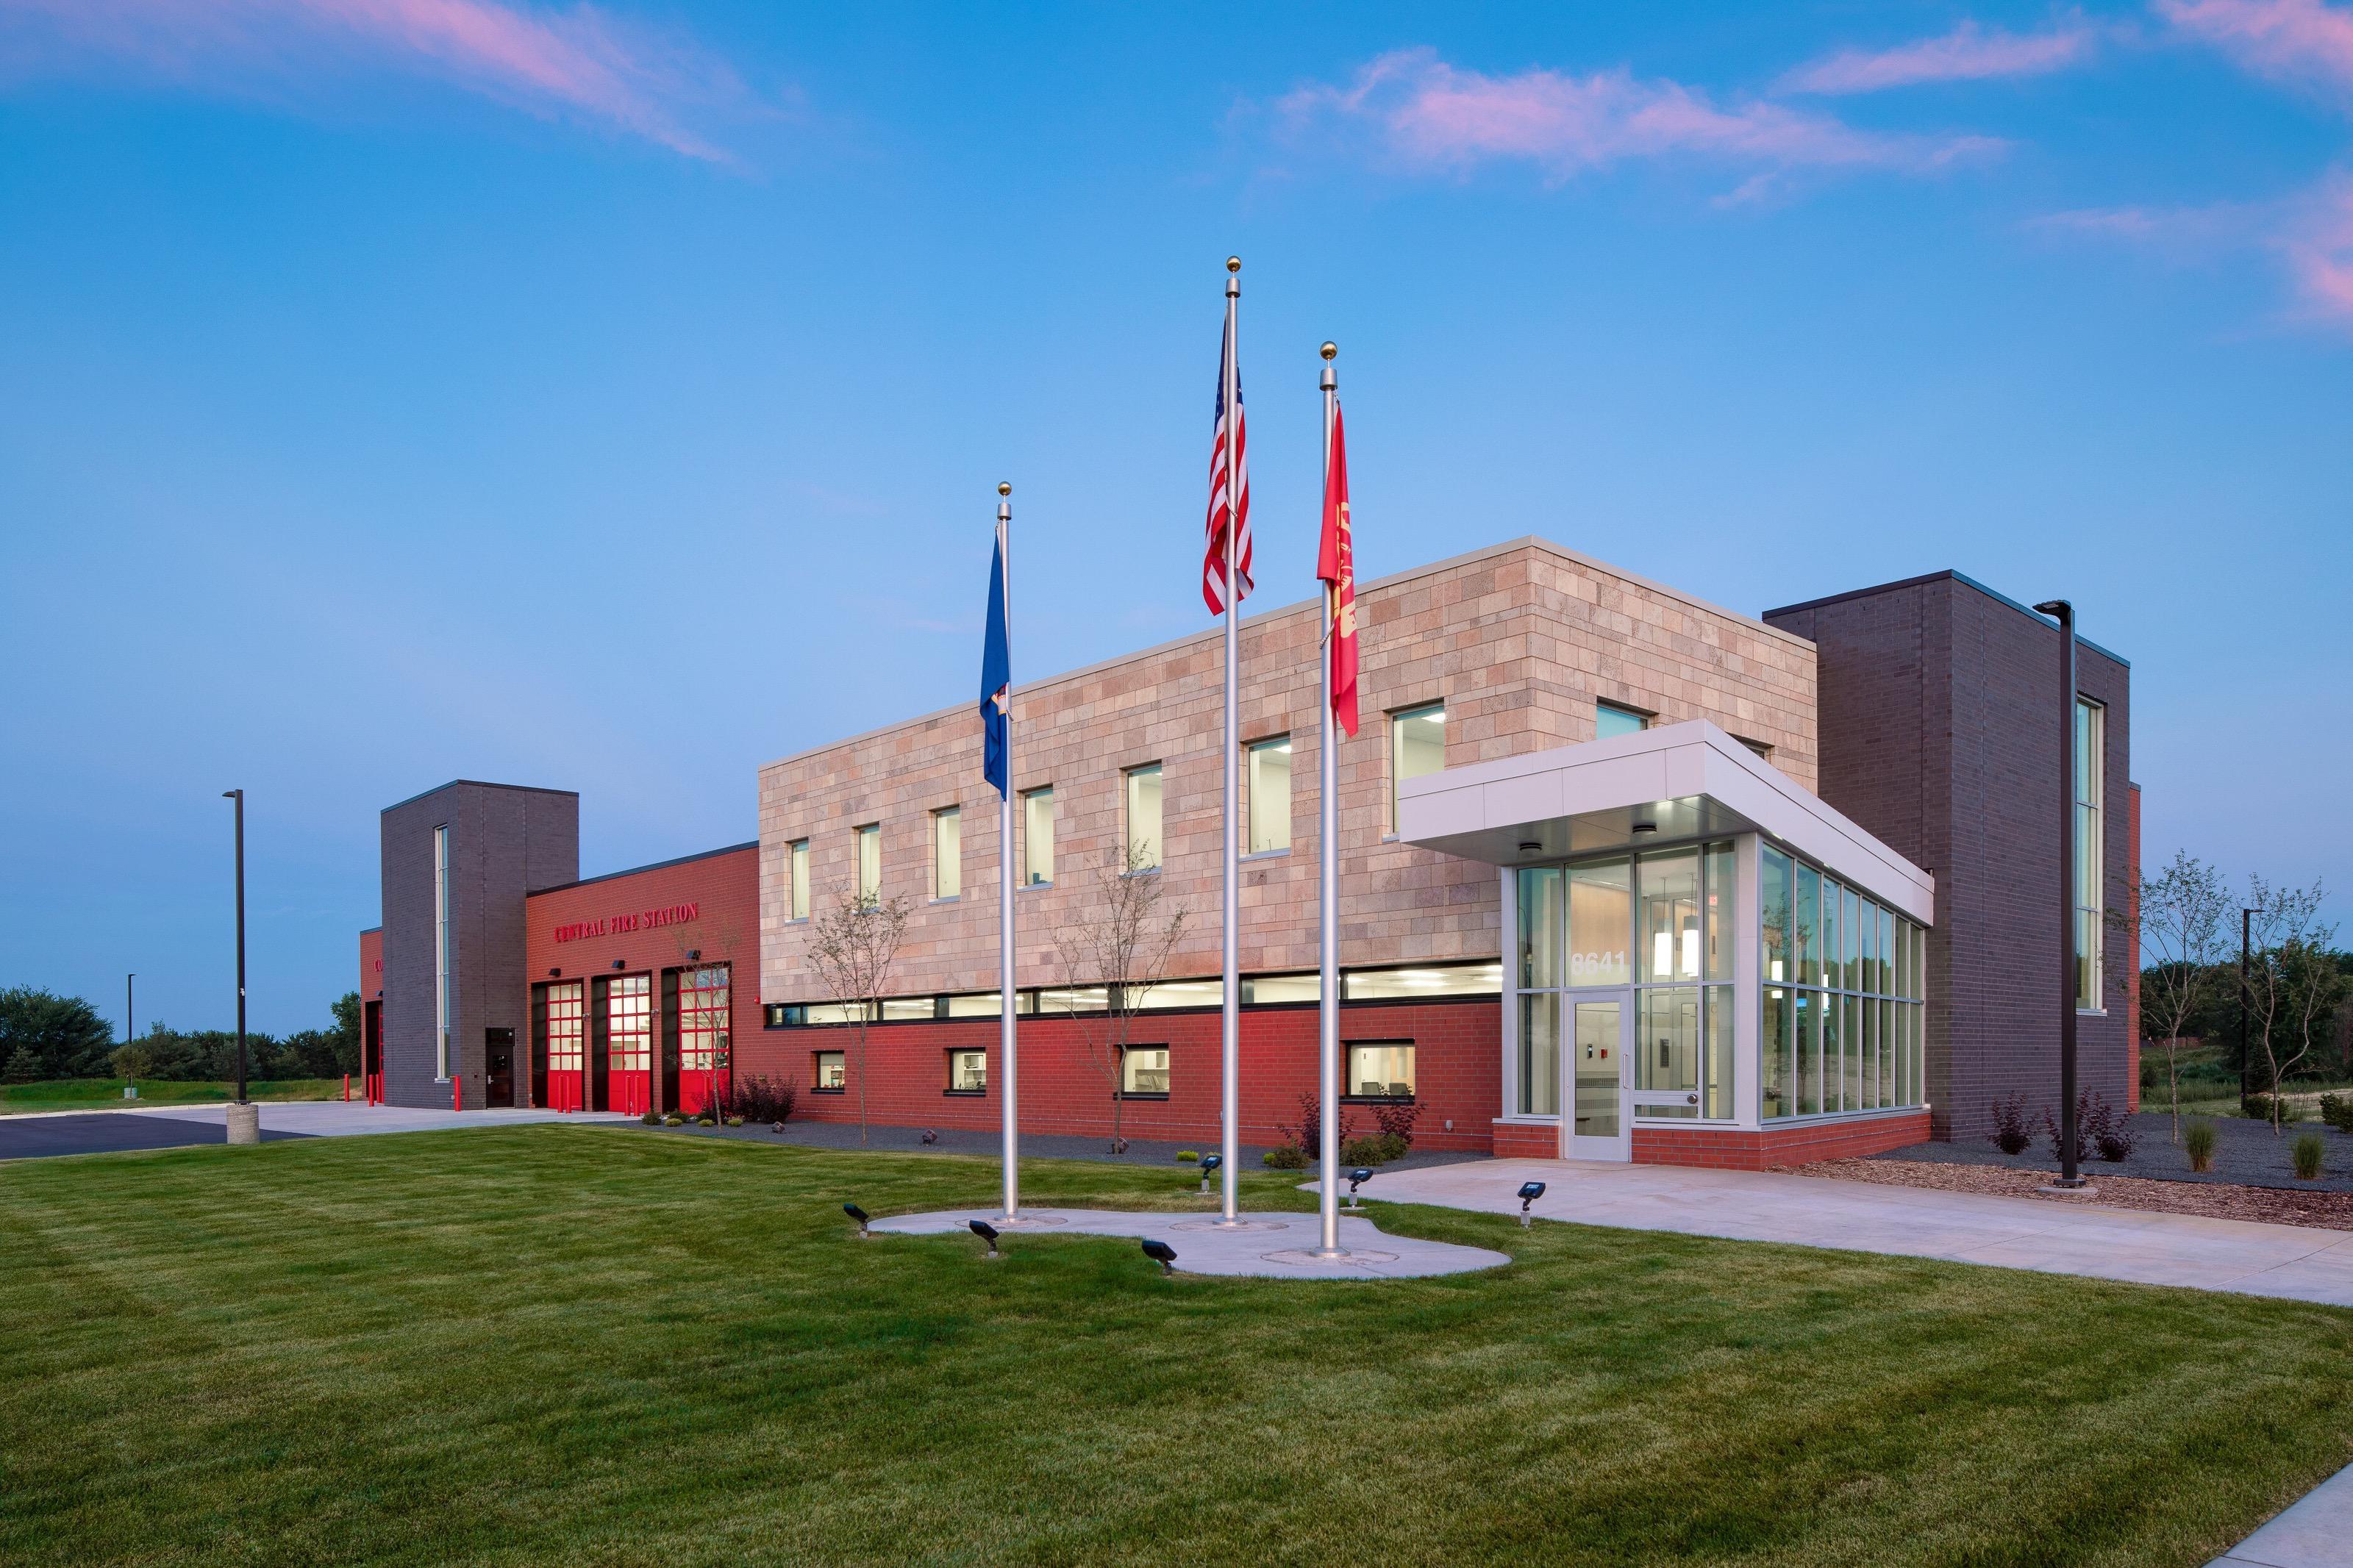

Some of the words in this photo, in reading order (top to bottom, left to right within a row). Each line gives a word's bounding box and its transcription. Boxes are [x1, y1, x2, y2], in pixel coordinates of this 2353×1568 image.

[610, 913, 638, 934] FIRE
[642, 902, 698, 928] STATION
[1571, 951, 1624, 976] 8641
